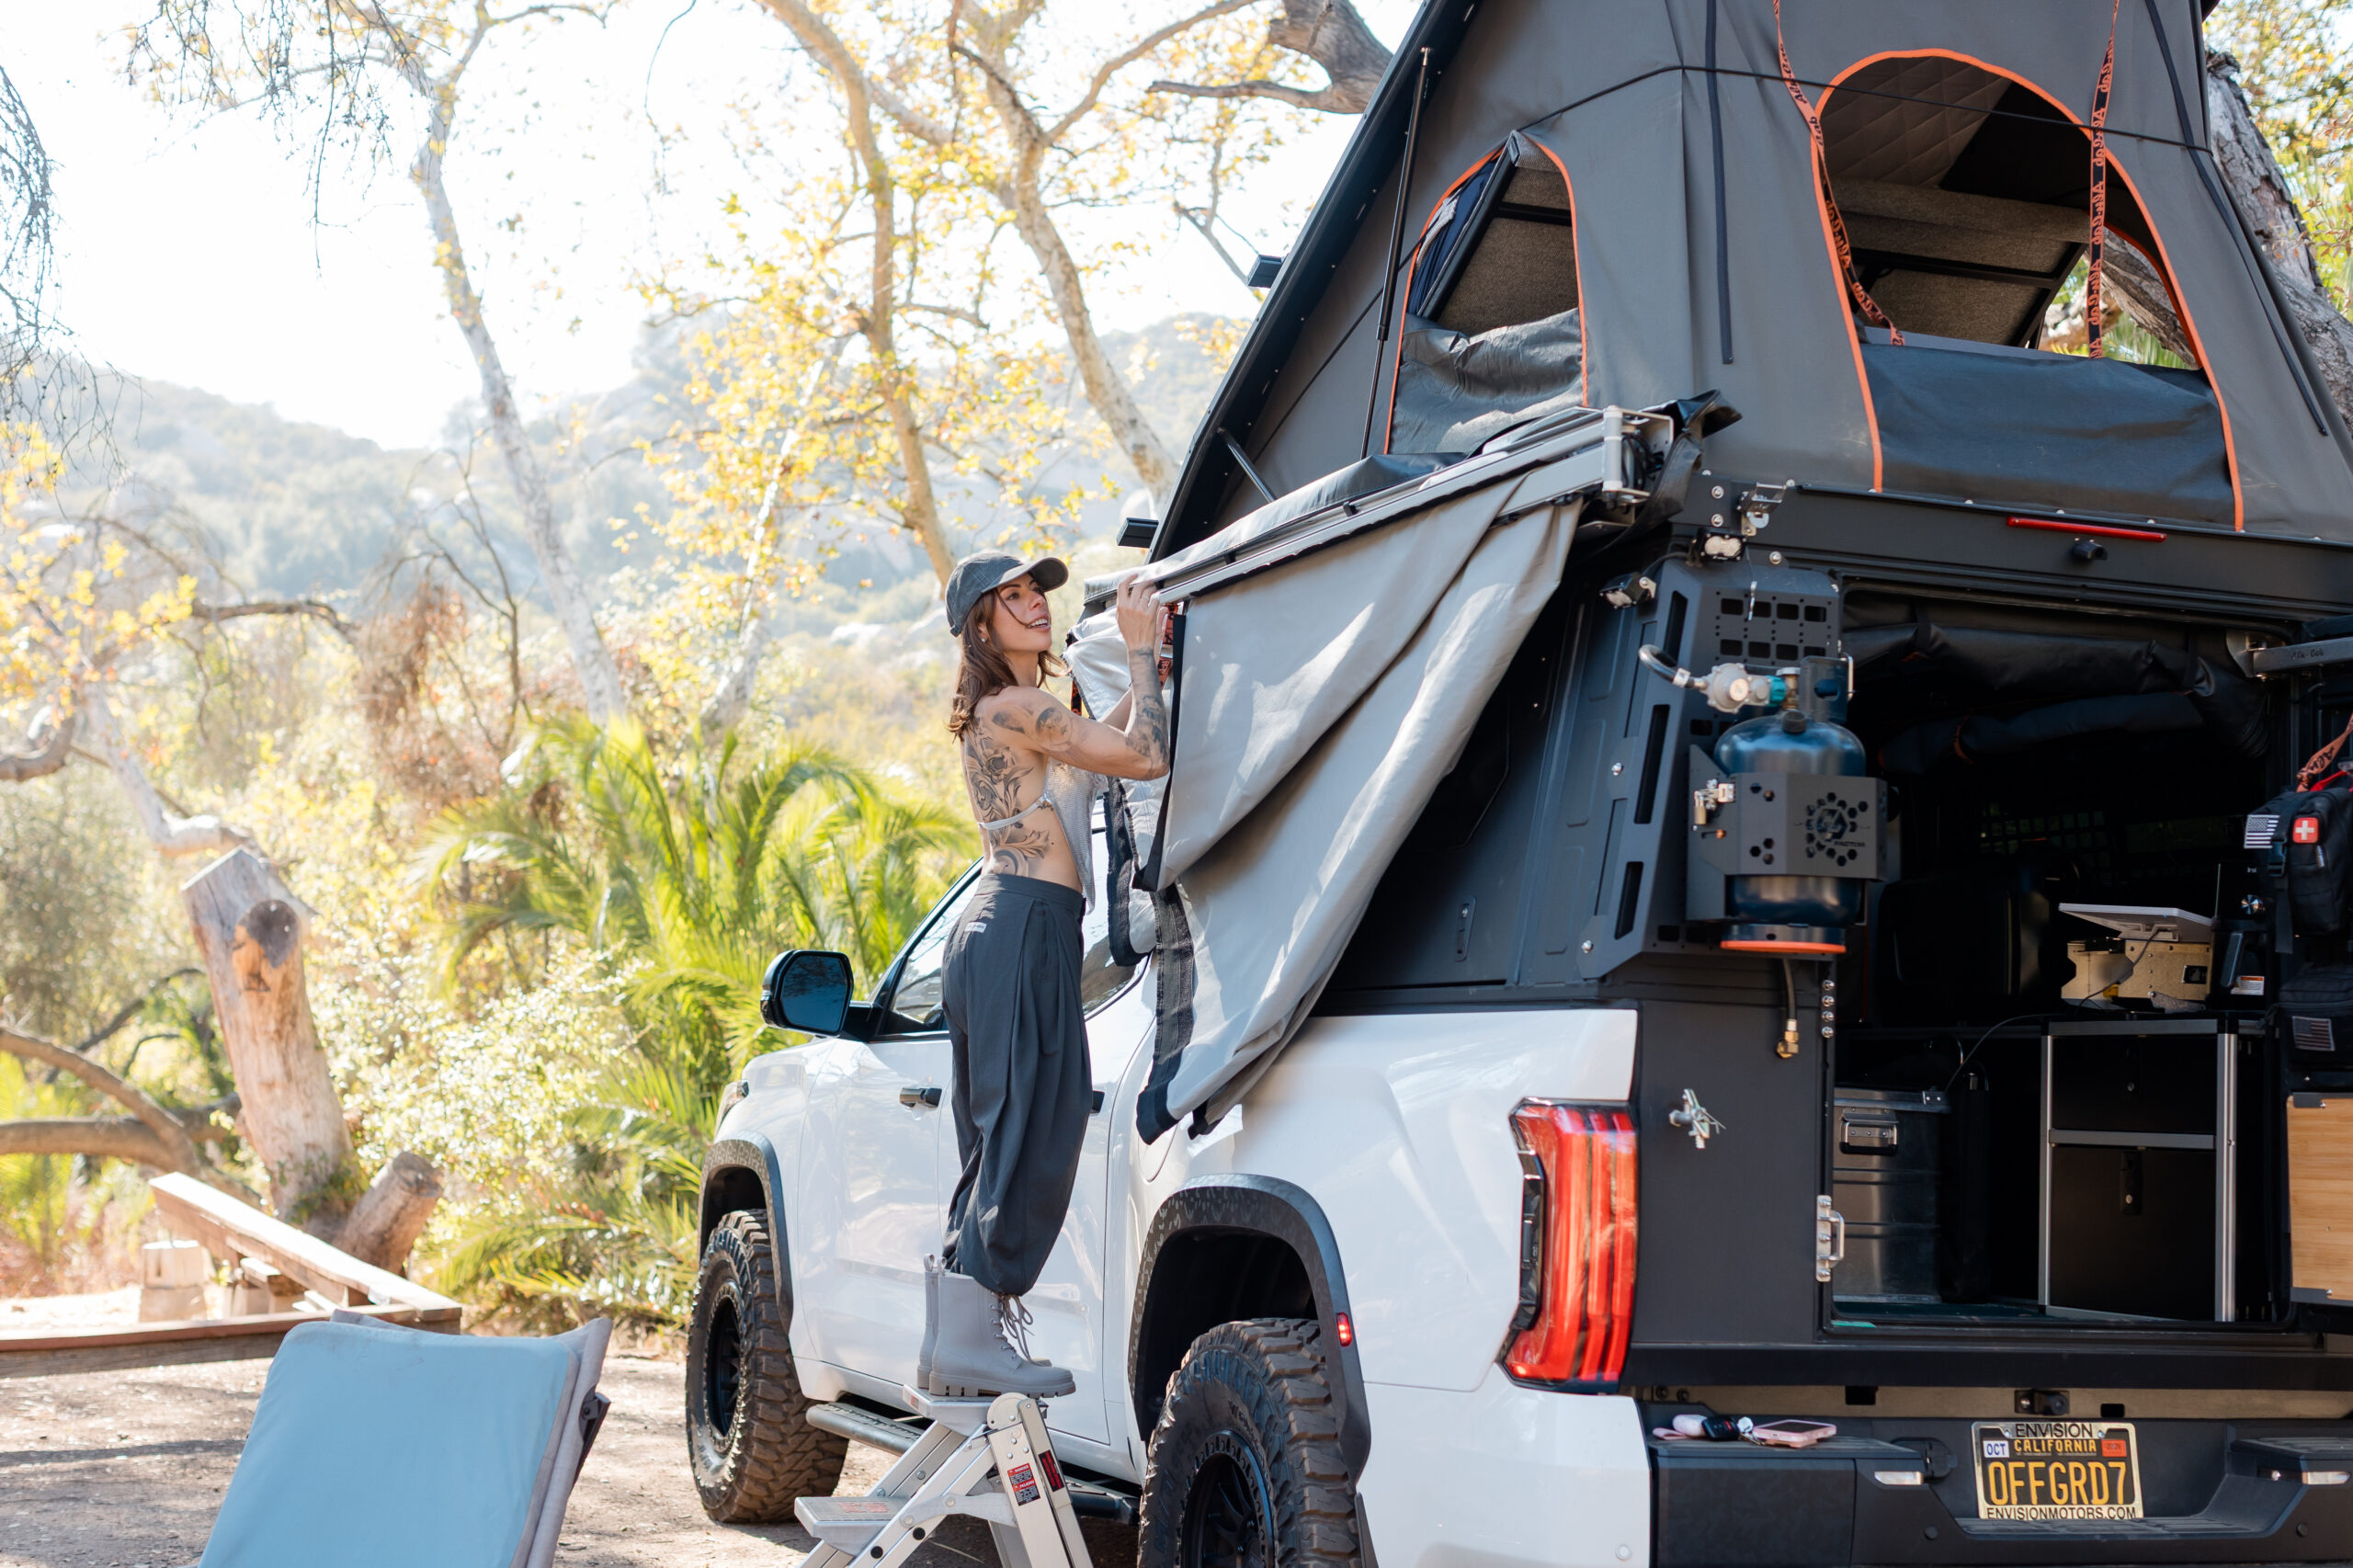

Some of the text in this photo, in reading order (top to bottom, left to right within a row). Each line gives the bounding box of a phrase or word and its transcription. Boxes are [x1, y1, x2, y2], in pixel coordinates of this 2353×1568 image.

[2016, 1424, 2093, 1437] ENVISION
[1986, 1443, 2006, 1456] OCT
[2014, 1439, 2097, 1452] CALIFORNIA
[1986, 1507, 2136, 1519] ENVISIONMOTORS.COM
